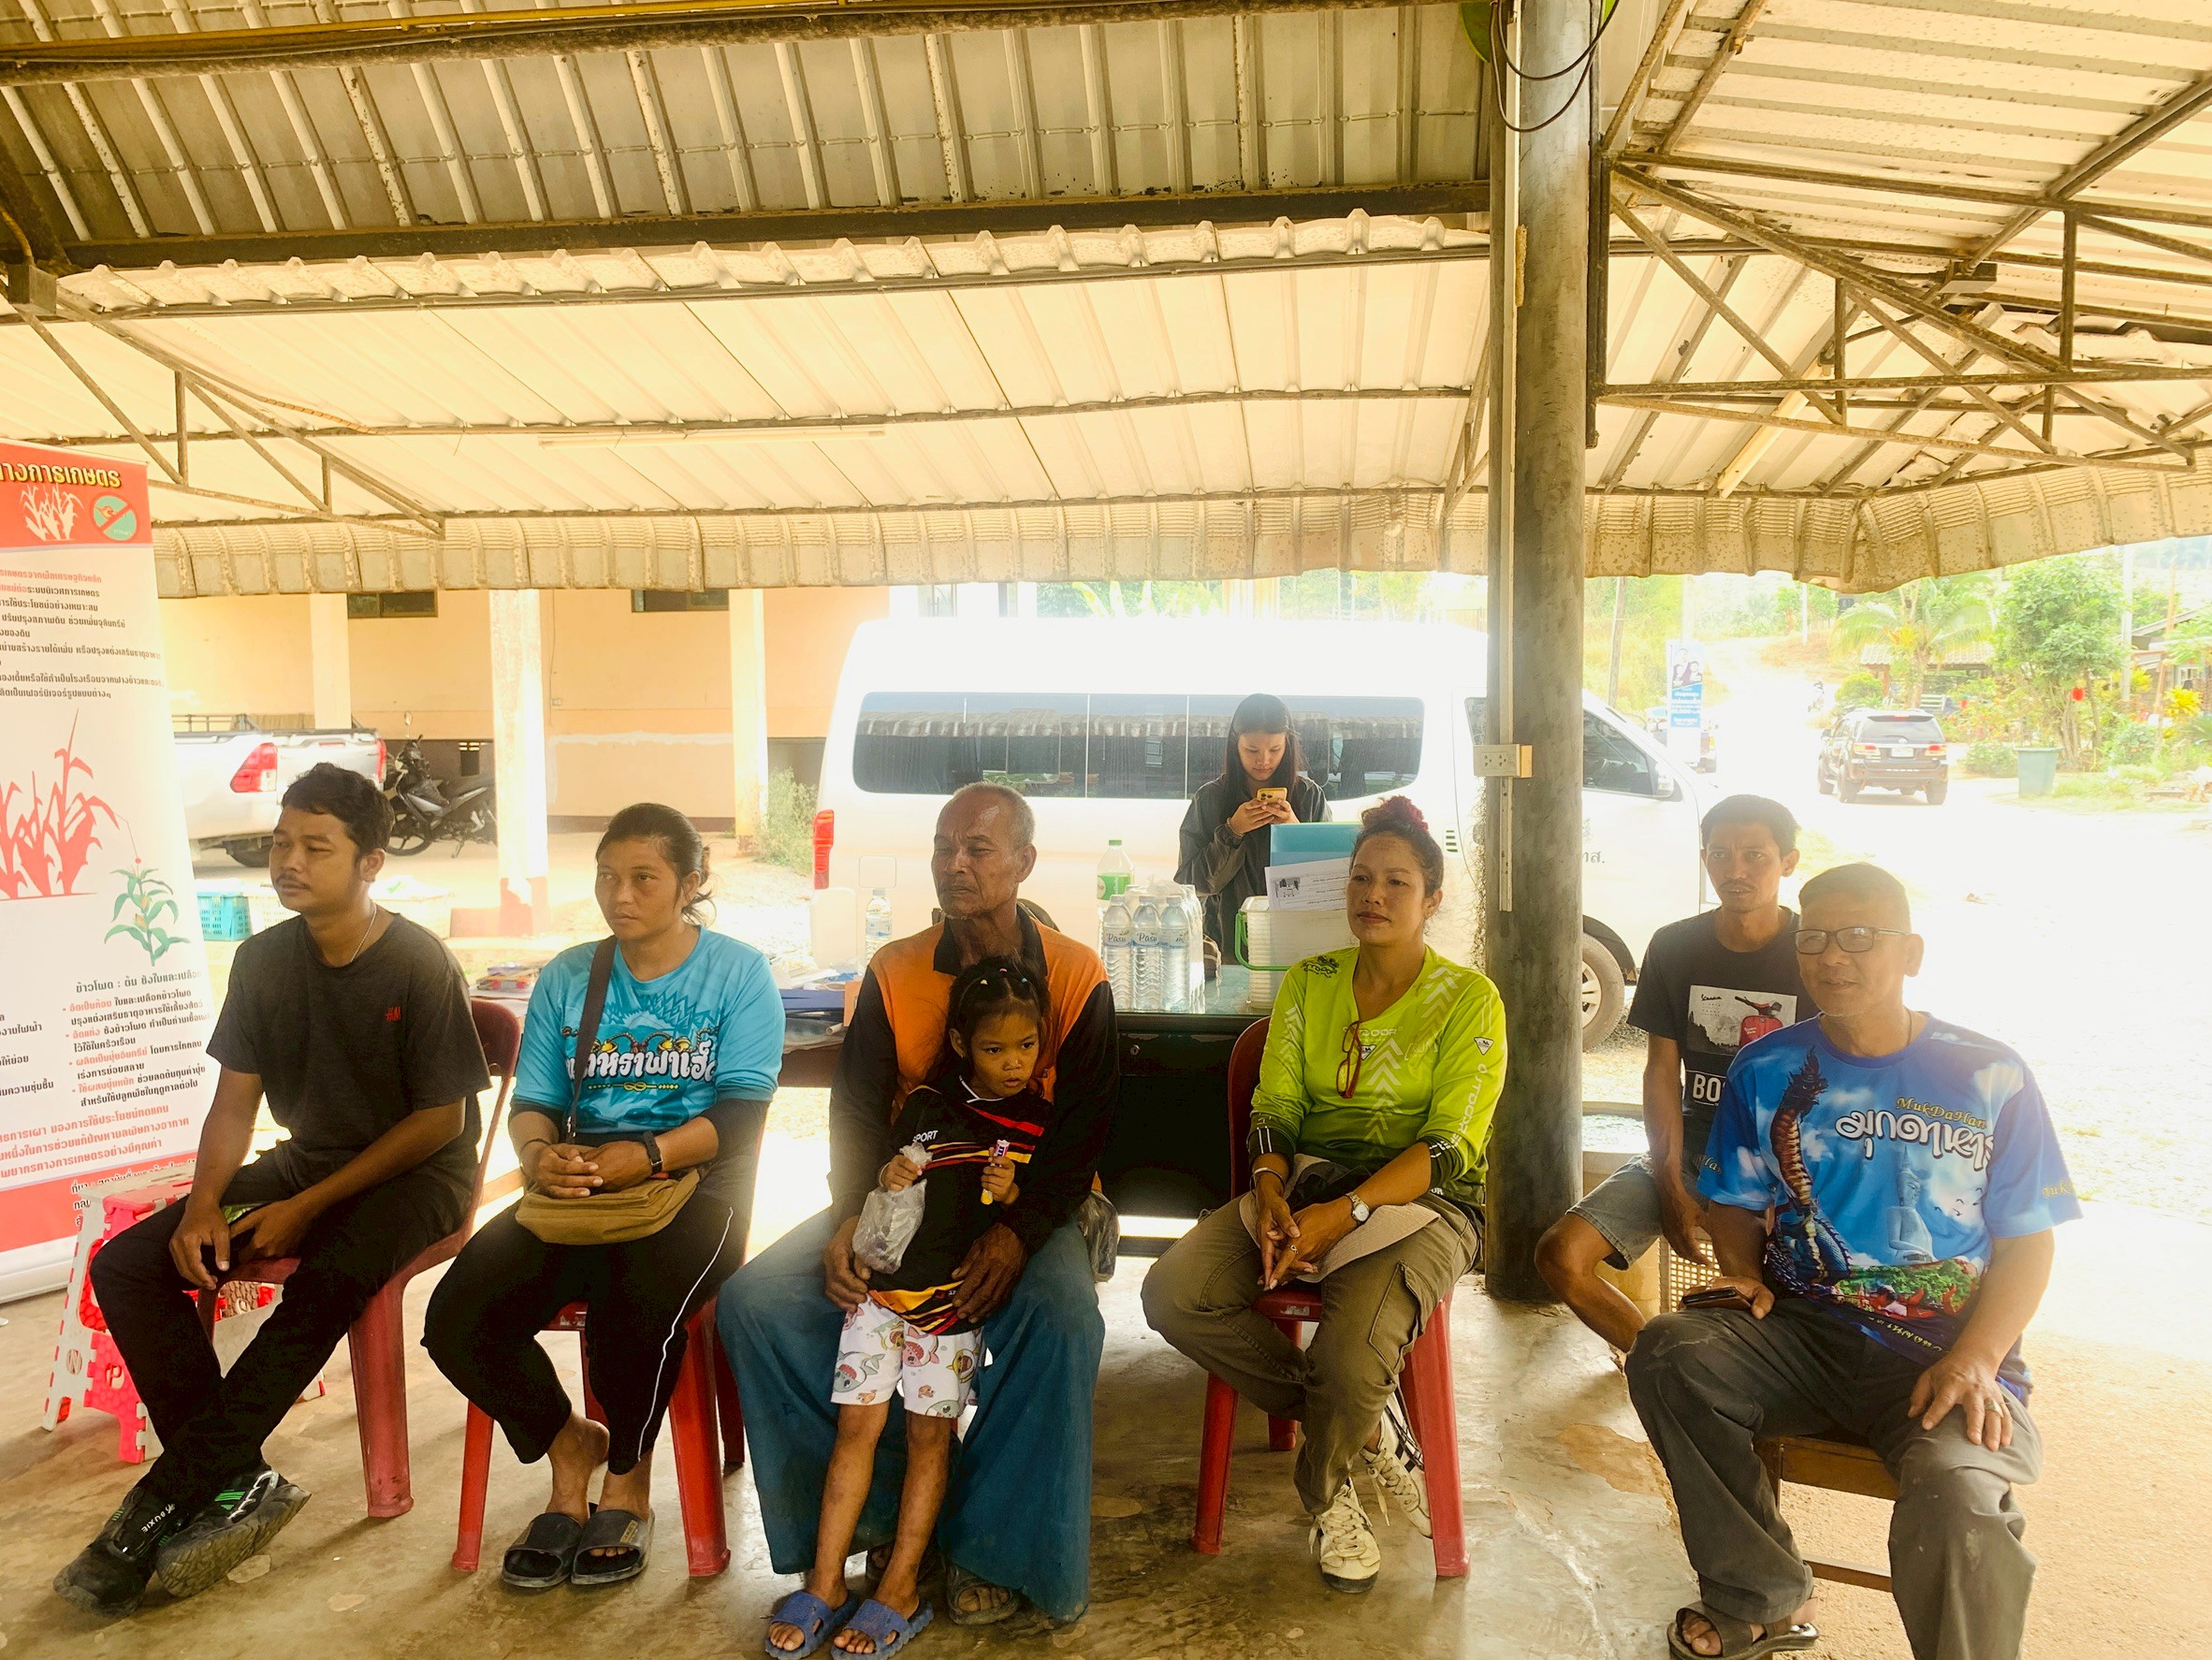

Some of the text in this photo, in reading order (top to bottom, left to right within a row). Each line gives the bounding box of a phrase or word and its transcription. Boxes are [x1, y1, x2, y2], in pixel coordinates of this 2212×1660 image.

[0, 462, 122, 488] างการเกษตร
[0, 597, 98, 611] ารใช้ประโยชน์อย่างเหมาะสม
[76, 981, 113, 993] ข้าวโพด
[1693, 1073, 1725, 1102] BO
